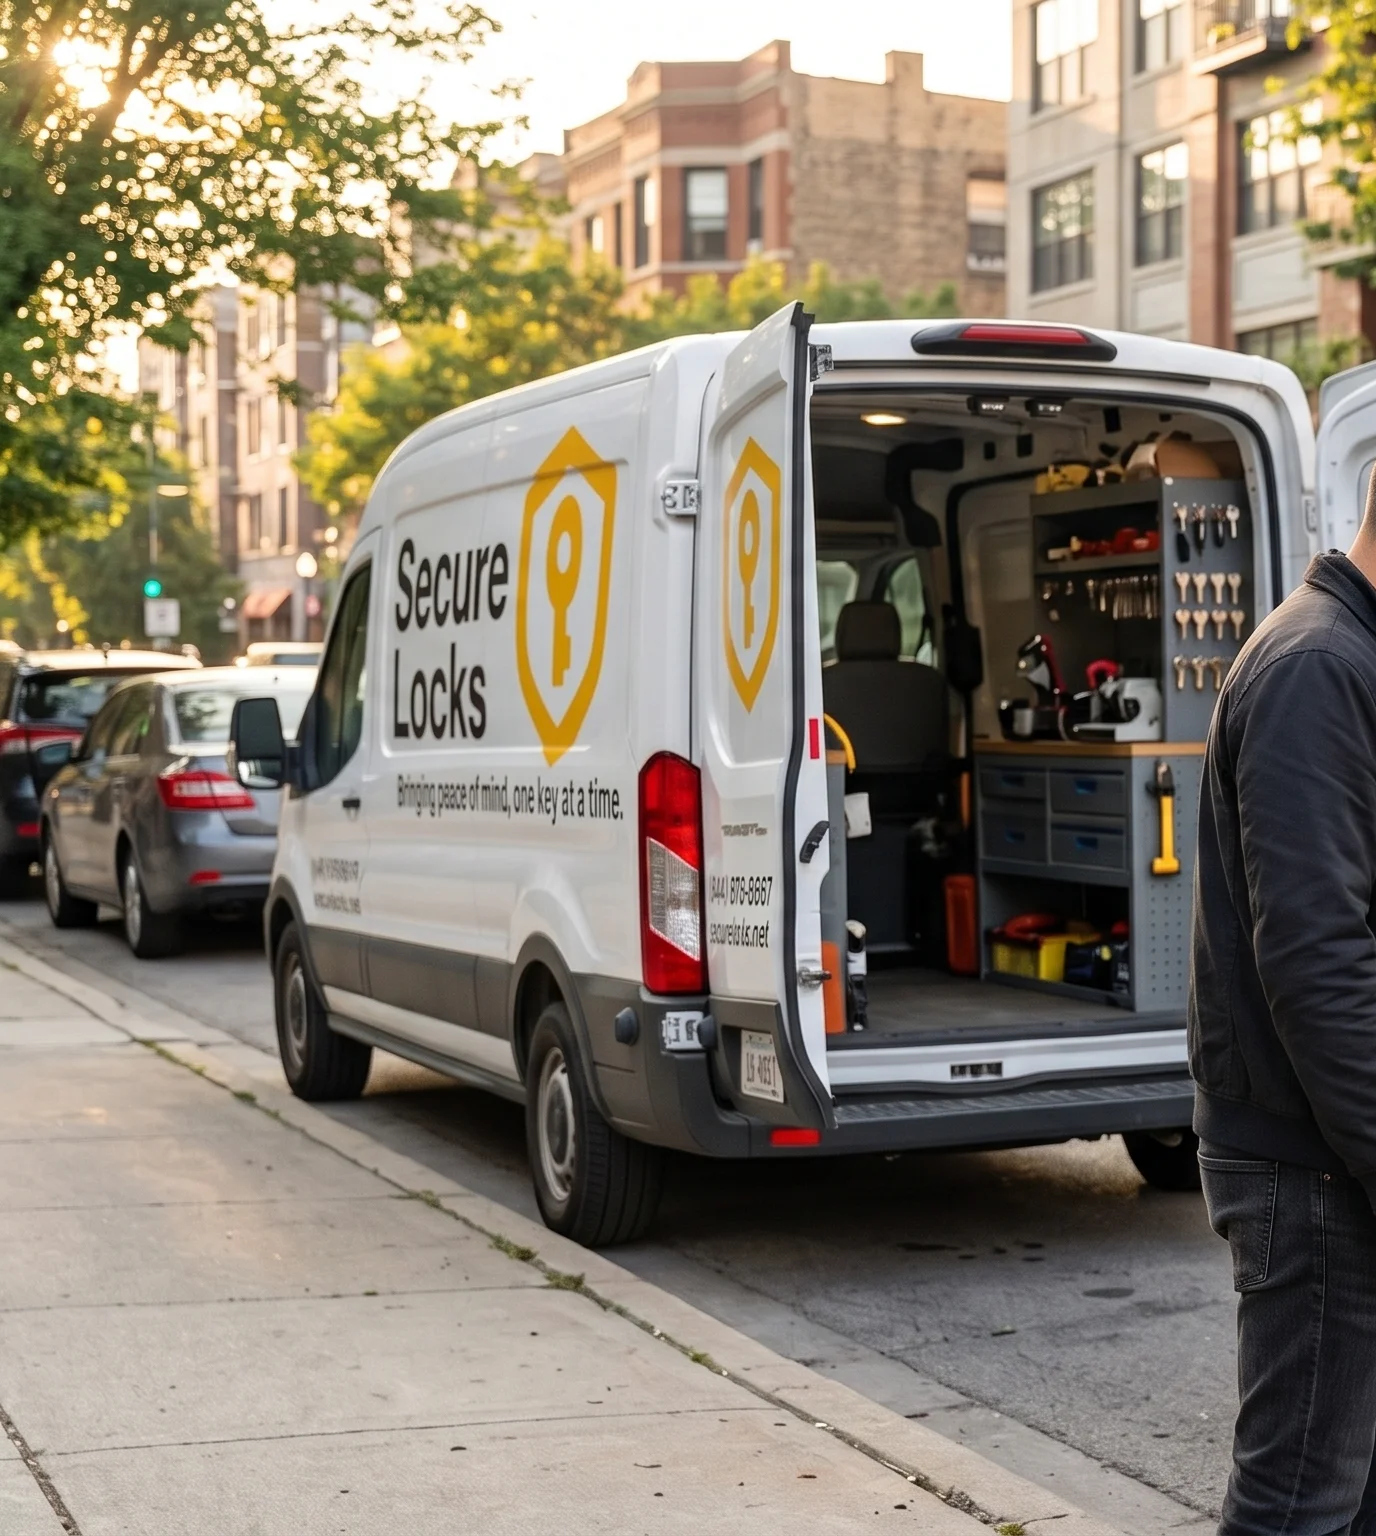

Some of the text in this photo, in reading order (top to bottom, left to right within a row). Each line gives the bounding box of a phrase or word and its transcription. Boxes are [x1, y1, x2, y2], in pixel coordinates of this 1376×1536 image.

[395, 538, 509, 632] Secure
[394, 642, 487, 740] Locks
[398, 773, 624, 826] Bringing peace of mind, one key at a time.
[730, 875, 773, 907] 878-8667
